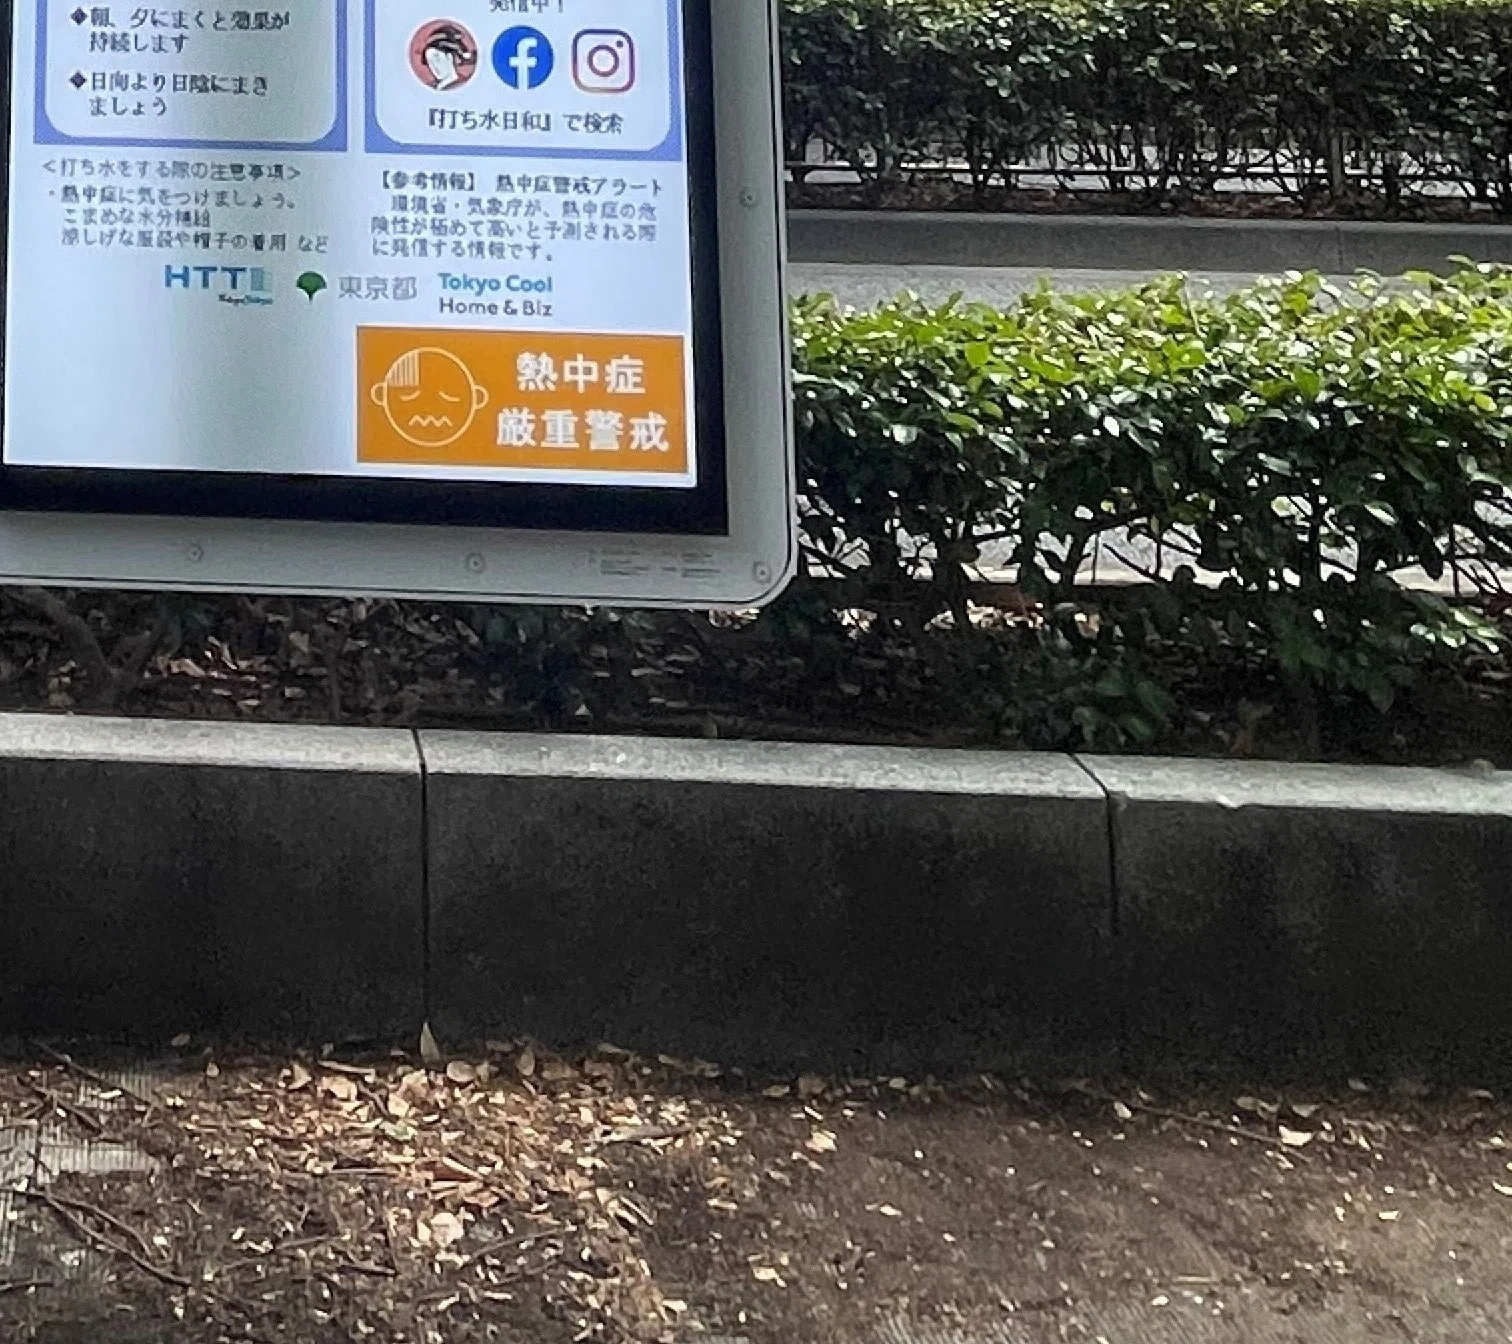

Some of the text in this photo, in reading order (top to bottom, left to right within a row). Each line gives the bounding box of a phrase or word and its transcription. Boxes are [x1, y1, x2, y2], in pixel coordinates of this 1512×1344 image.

[89, 31, 188, 54] 持続します
[90, 96, 167, 117] ましょう
[339, 275, 417, 301] 東京都
[438, 272, 553, 297] Tokyo Cool
[438, 297, 553, 317] Home & Biz
[516, 351, 646, 395] 熱中症
[496, 407, 670, 452] 厳重警戒
